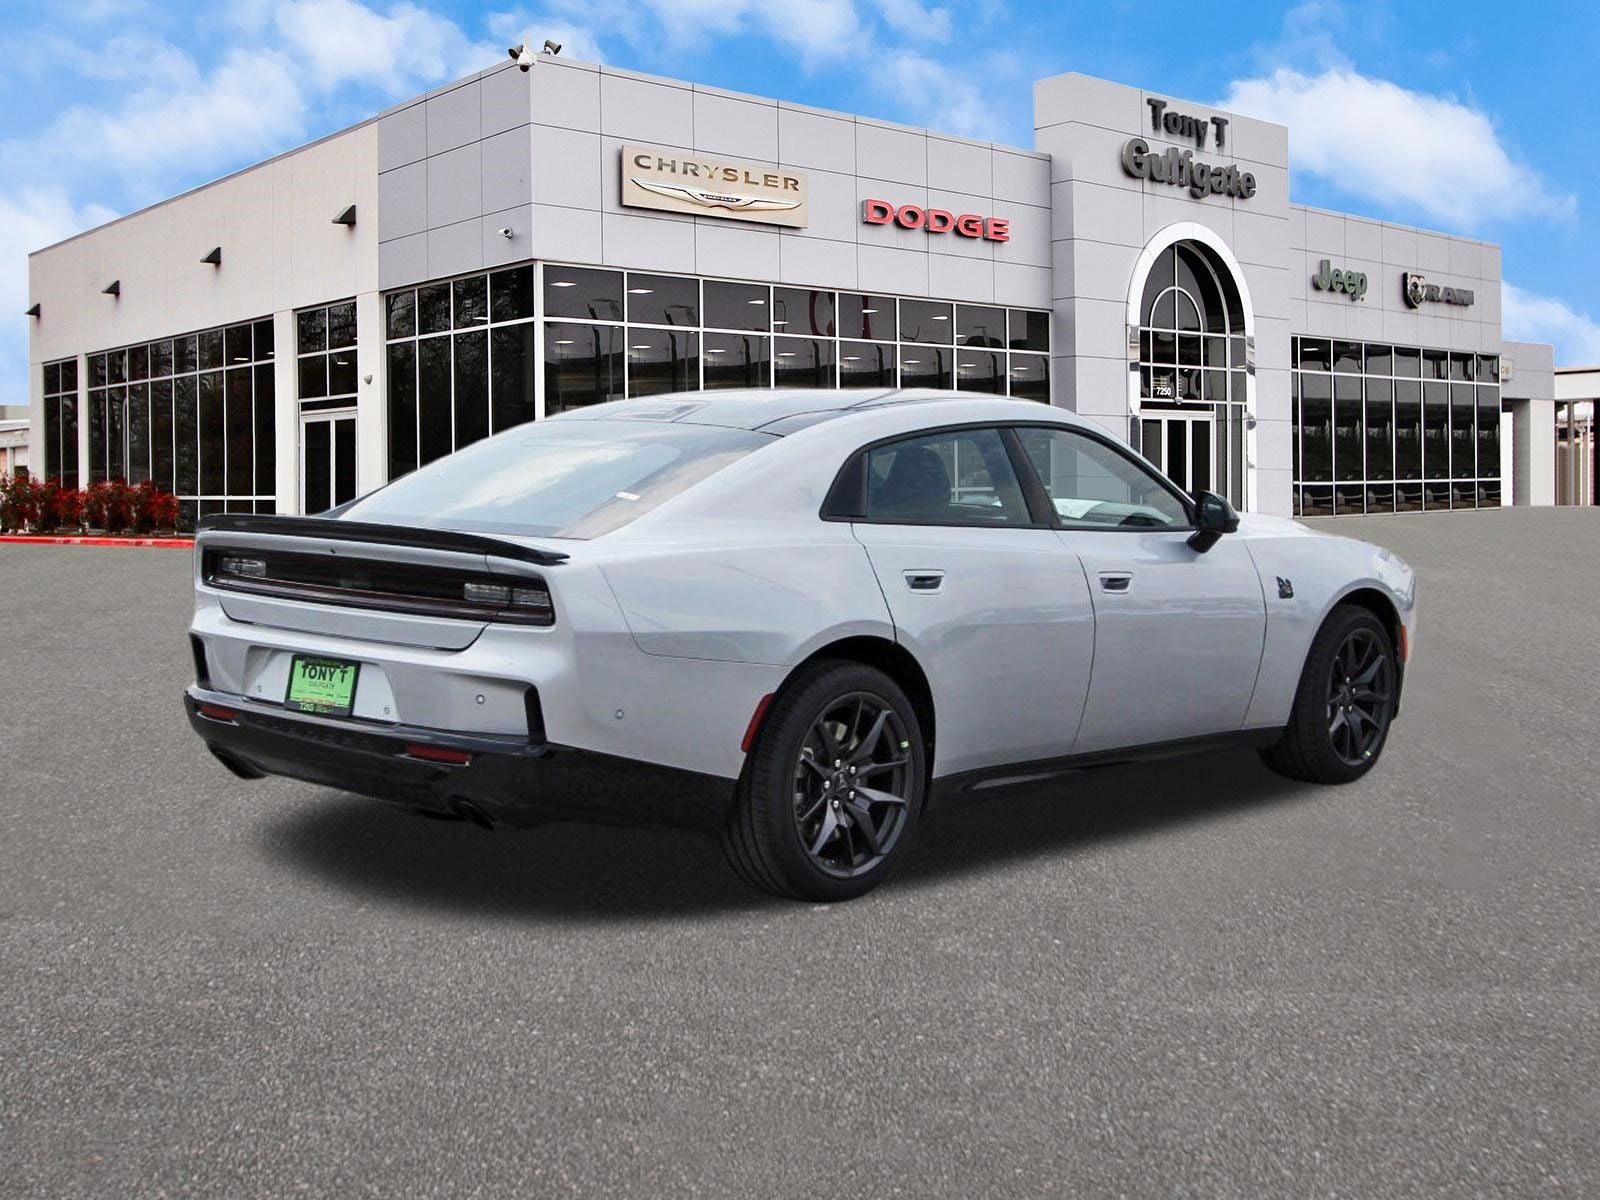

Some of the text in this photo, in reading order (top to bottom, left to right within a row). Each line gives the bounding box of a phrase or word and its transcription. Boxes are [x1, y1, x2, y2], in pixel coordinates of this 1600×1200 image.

[1147, 98, 1229, 148] Tony T
[633, 154, 800, 192] CHRYSLER
[1121, 138, 1257, 199] Gulfgate
[862, 198, 1010, 242] DODGE
[1312, 259, 1368, 302] Jeep
[1425, 284, 1475, 306] RAM
[1156, 386, 1171, 396] 7250
[301, 664, 348, 683] TONY T
